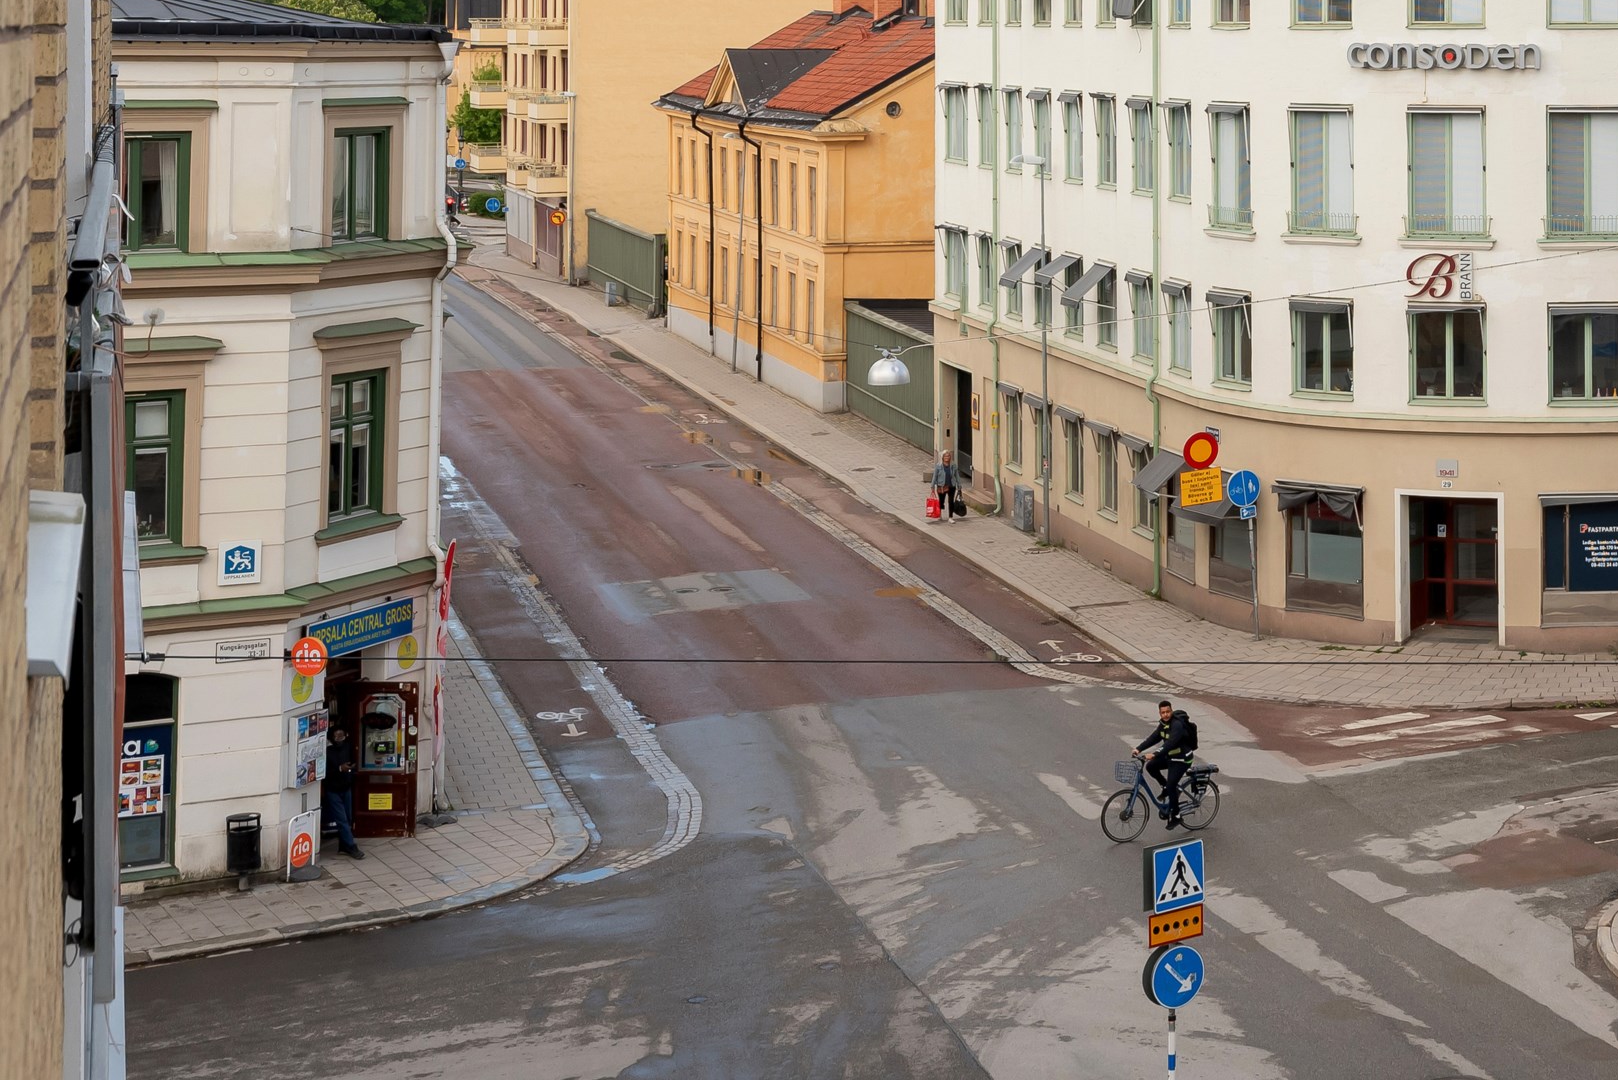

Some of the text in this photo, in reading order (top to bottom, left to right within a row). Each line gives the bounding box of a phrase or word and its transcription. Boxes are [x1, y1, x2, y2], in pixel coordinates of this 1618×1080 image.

[1460, 253, 1472, 299] BRANN
[348, 612, 384, 637] CENTRAL
[385, 603, 412, 624] GROSS
[219, 642, 268, 652] Kungsängsgatan
[295, 642, 321, 663] ria
[293, 838, 310, 857] ria
